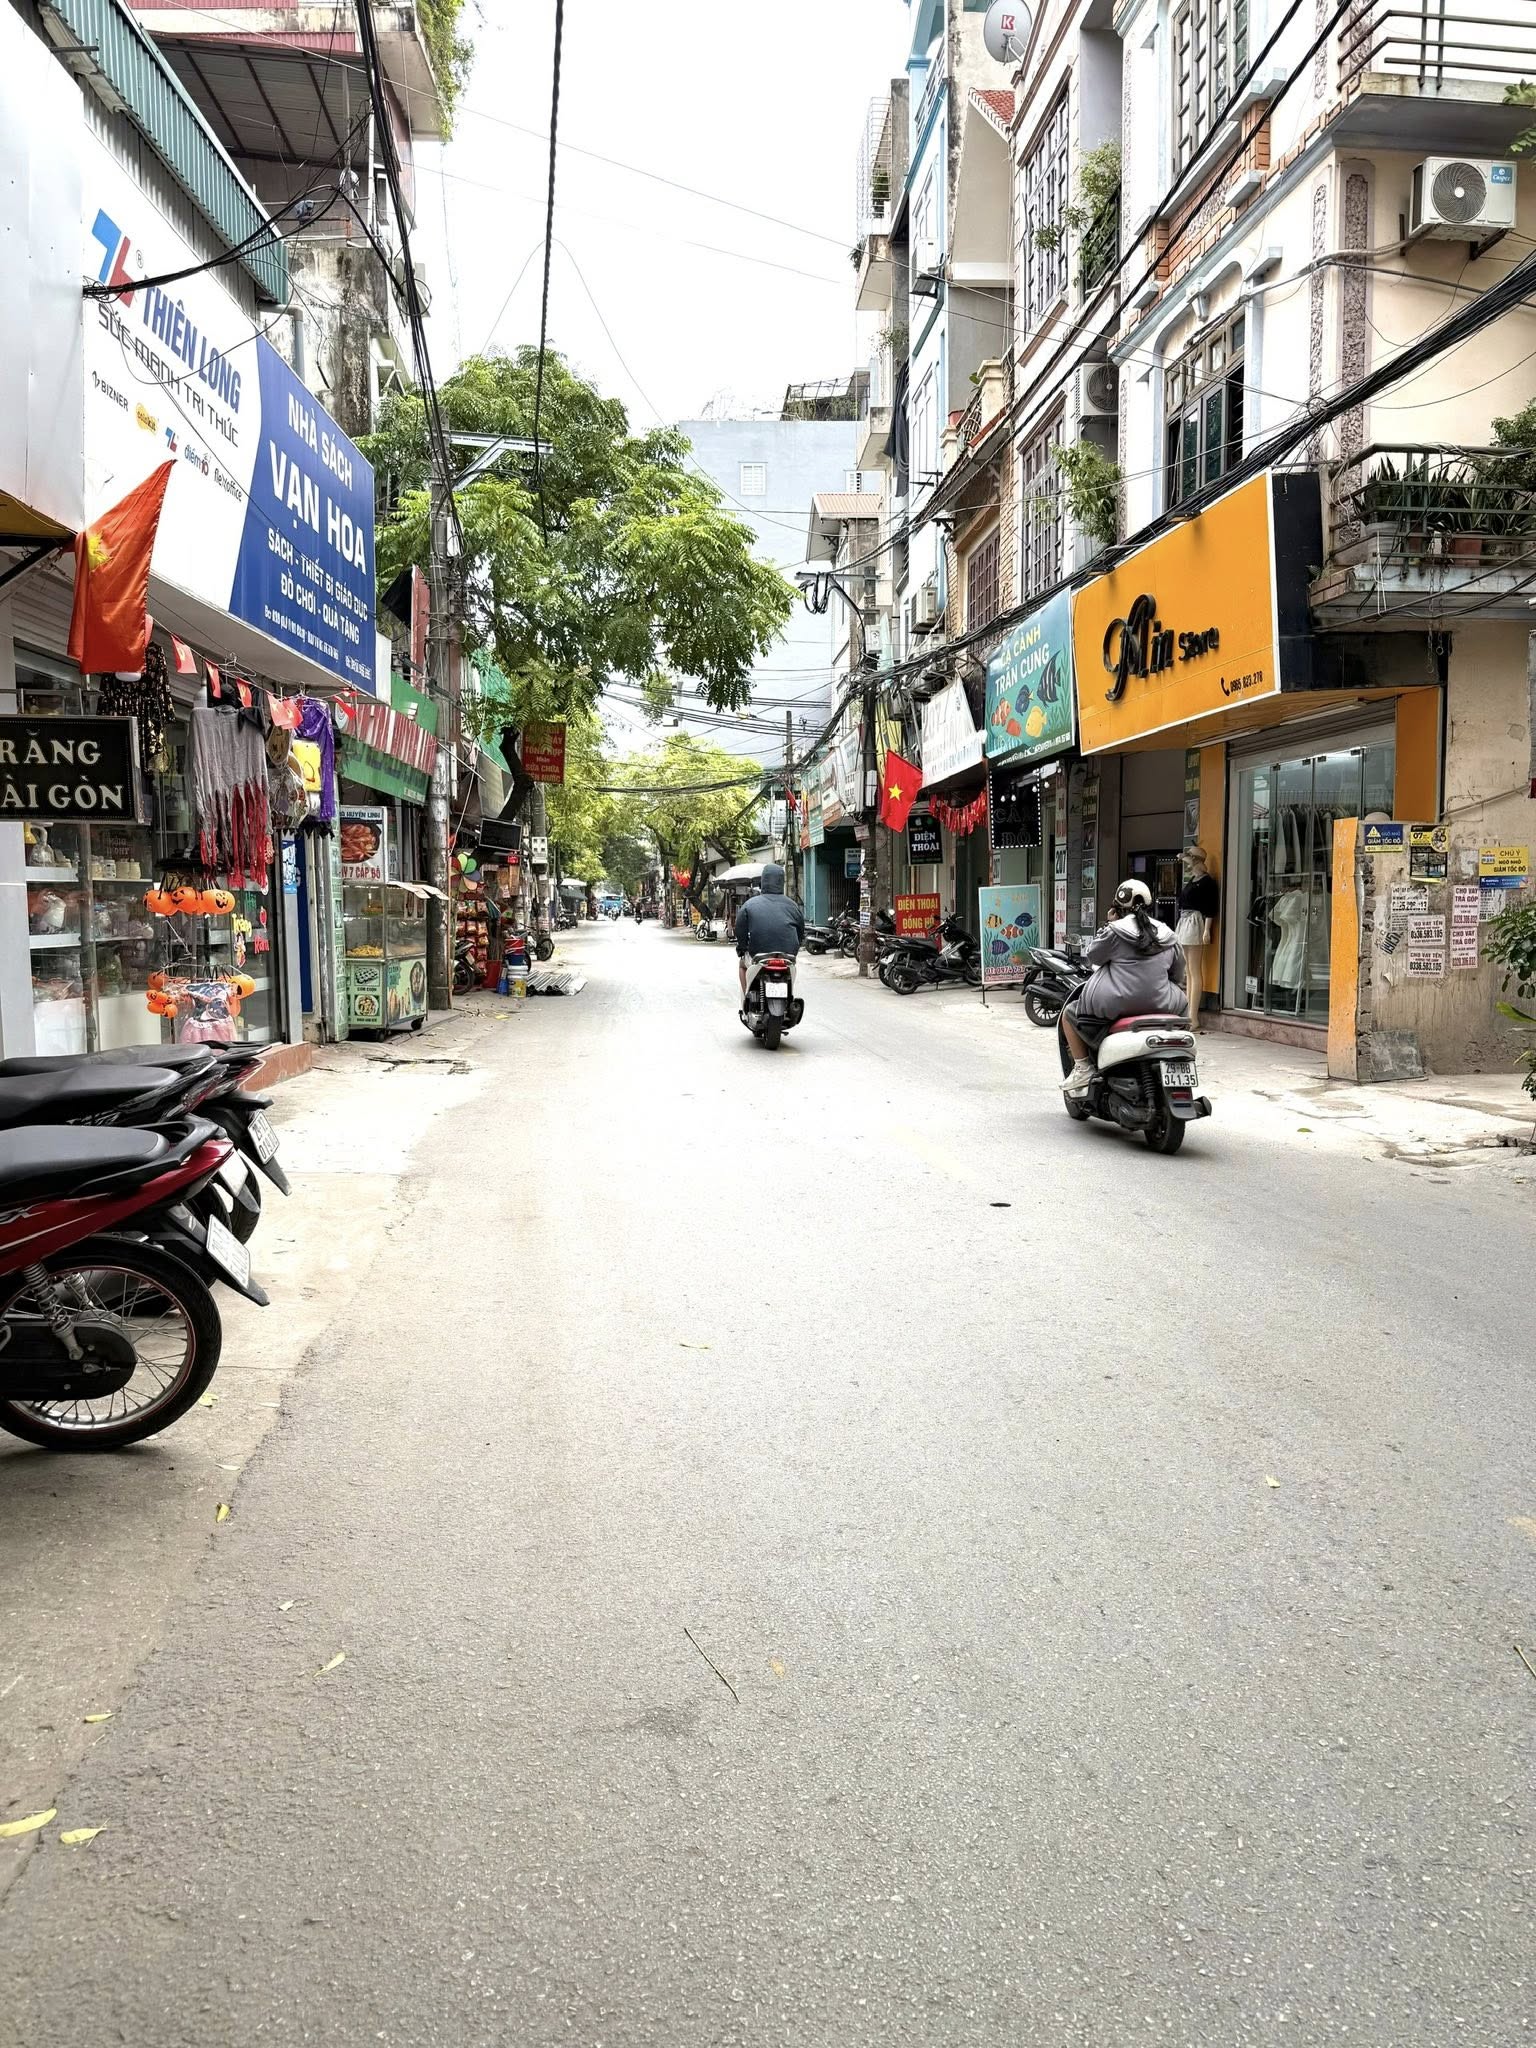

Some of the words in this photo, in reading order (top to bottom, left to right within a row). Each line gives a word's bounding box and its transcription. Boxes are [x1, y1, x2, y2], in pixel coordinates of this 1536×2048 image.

[143, 274, 198, 370] THIÊN
[198, 335, 242, 414] LONG
[100, 380, 129, 411] BIZNER
[183, 382, 205, 417] TRI
[207, 403, 239, 448] THỨC
[288, 392, 319, 455] NHÀ
[321, 431, 353, 492] SÁCH
[269, 439, 320, 534] VẠN
[327, 497, 367, 576] HOA
[268, 527, 294, 566] SÁCH
[300, 552, 324, 588] THIẾT
[325, 573, 334, 601] BỊ
[335, 581, 353, 610] GIÁO
[353, 595, 368, 623] DỤC
[280, 568, 294, 600] ĐỒ
[296, 583, 316, 616] CHƠI
[322, 603, 339, 631] QUÀ
[340, 616, 360, 645] TẶNG
[1013, 623, 1041, 656] CẢNH
[1020, 643, 1050, 679] CUNG
[0, 729, 102, 765] RĂNG
[48, 775, 123, 809] GÒN
[911, 843, 940, 853] THOẠI
[914, 831, 936, 843] ĐIỆN
[1499, 849, 1514, 857] CHÚ
[1516, 848, 1521, 856] Ý
[1507, 865, 1518, 873] TỐC
[1518, 865, 1527, 873] ĐỘ
[898, 896, 916, 913] ĐIỆN
[916, 897, 938, 912] THOẠI
[902, 915, 923, 930] ĐỒNG
[1452, 937, 1463, 945] TRẢ
[1464, 937, 1475, 945] GÓP
